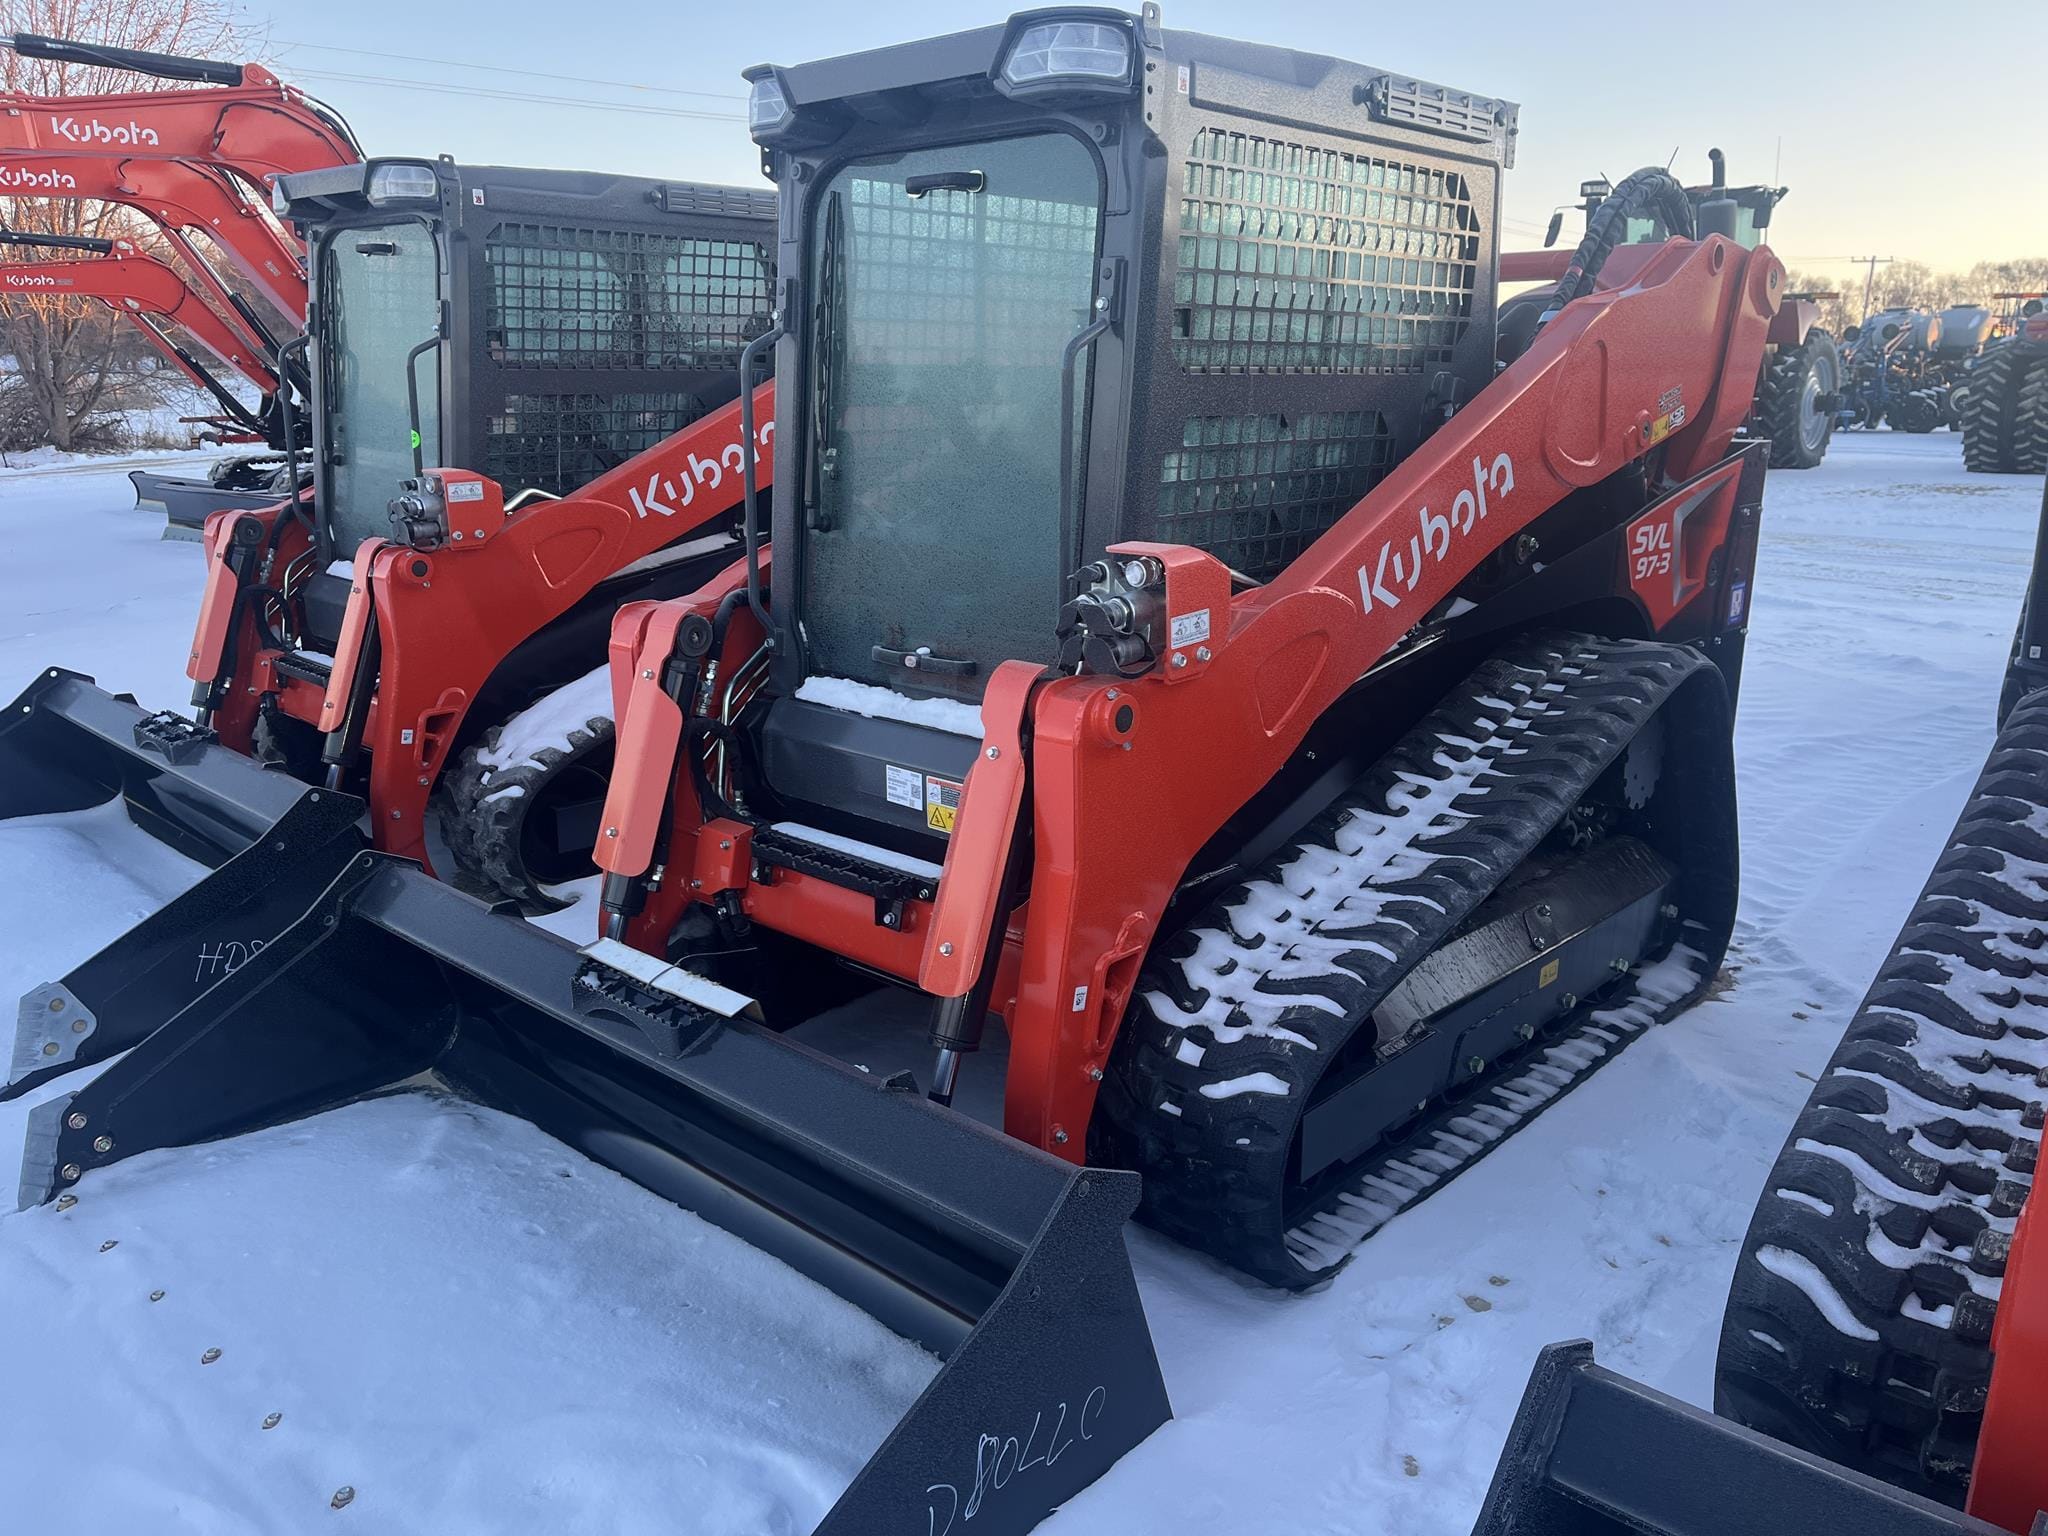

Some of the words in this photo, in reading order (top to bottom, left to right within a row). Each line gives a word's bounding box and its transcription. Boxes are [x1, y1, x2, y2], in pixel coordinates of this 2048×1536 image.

[51, 116, 159, 146] Kubota
[6, 274, 55, 286] Kubota
[1357, 452, 1515, 615] Kubota
[1631, 523, 1671, 555] SVL
[1635, 552, 1671, 580] 97-3
